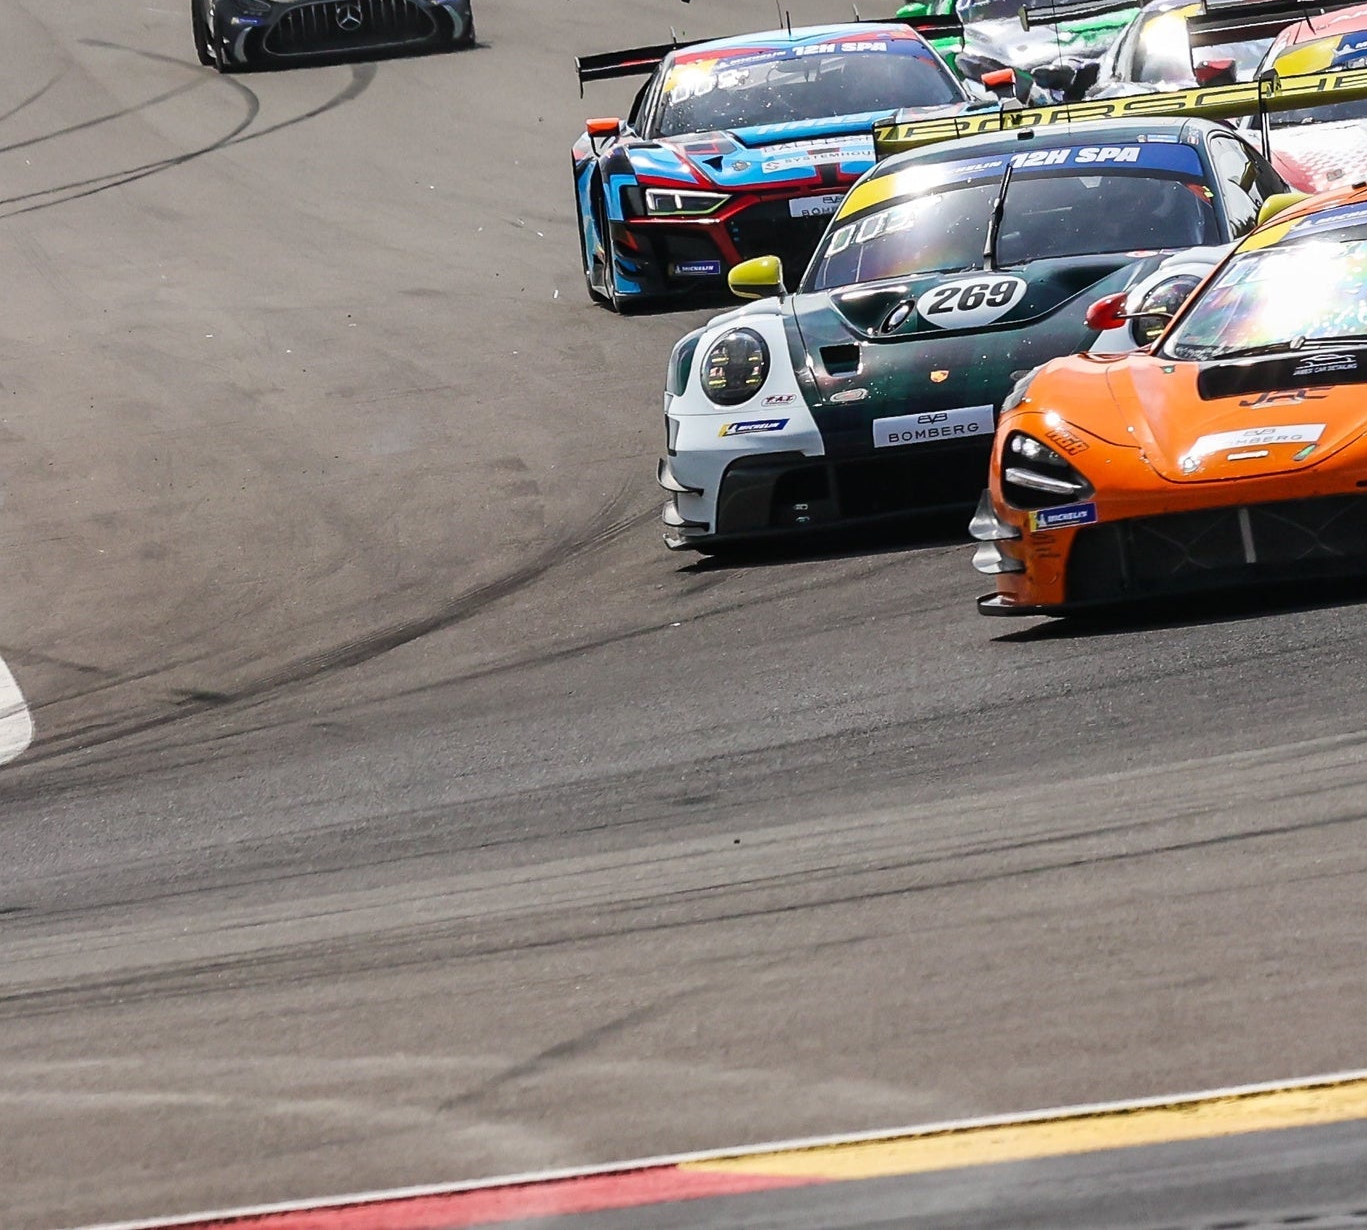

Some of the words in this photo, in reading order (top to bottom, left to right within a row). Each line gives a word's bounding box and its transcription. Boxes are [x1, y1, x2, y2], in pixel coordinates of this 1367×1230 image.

[791, 43, 836, 57] 12H
[840, 41, 888, 52] SPA
[784, 150, 872, 164] SYSTEMHOU
[1009, 148, 1072, 169] 12H
[1074, 146, 1141, 163] SPA
[926, 280, 1018, 316] 269
[737, 421, 780, 432] MICHELIN
[888, 422, 980, 443] BOMBERG
[1046, 509, 1088, 524] MICHELIN
